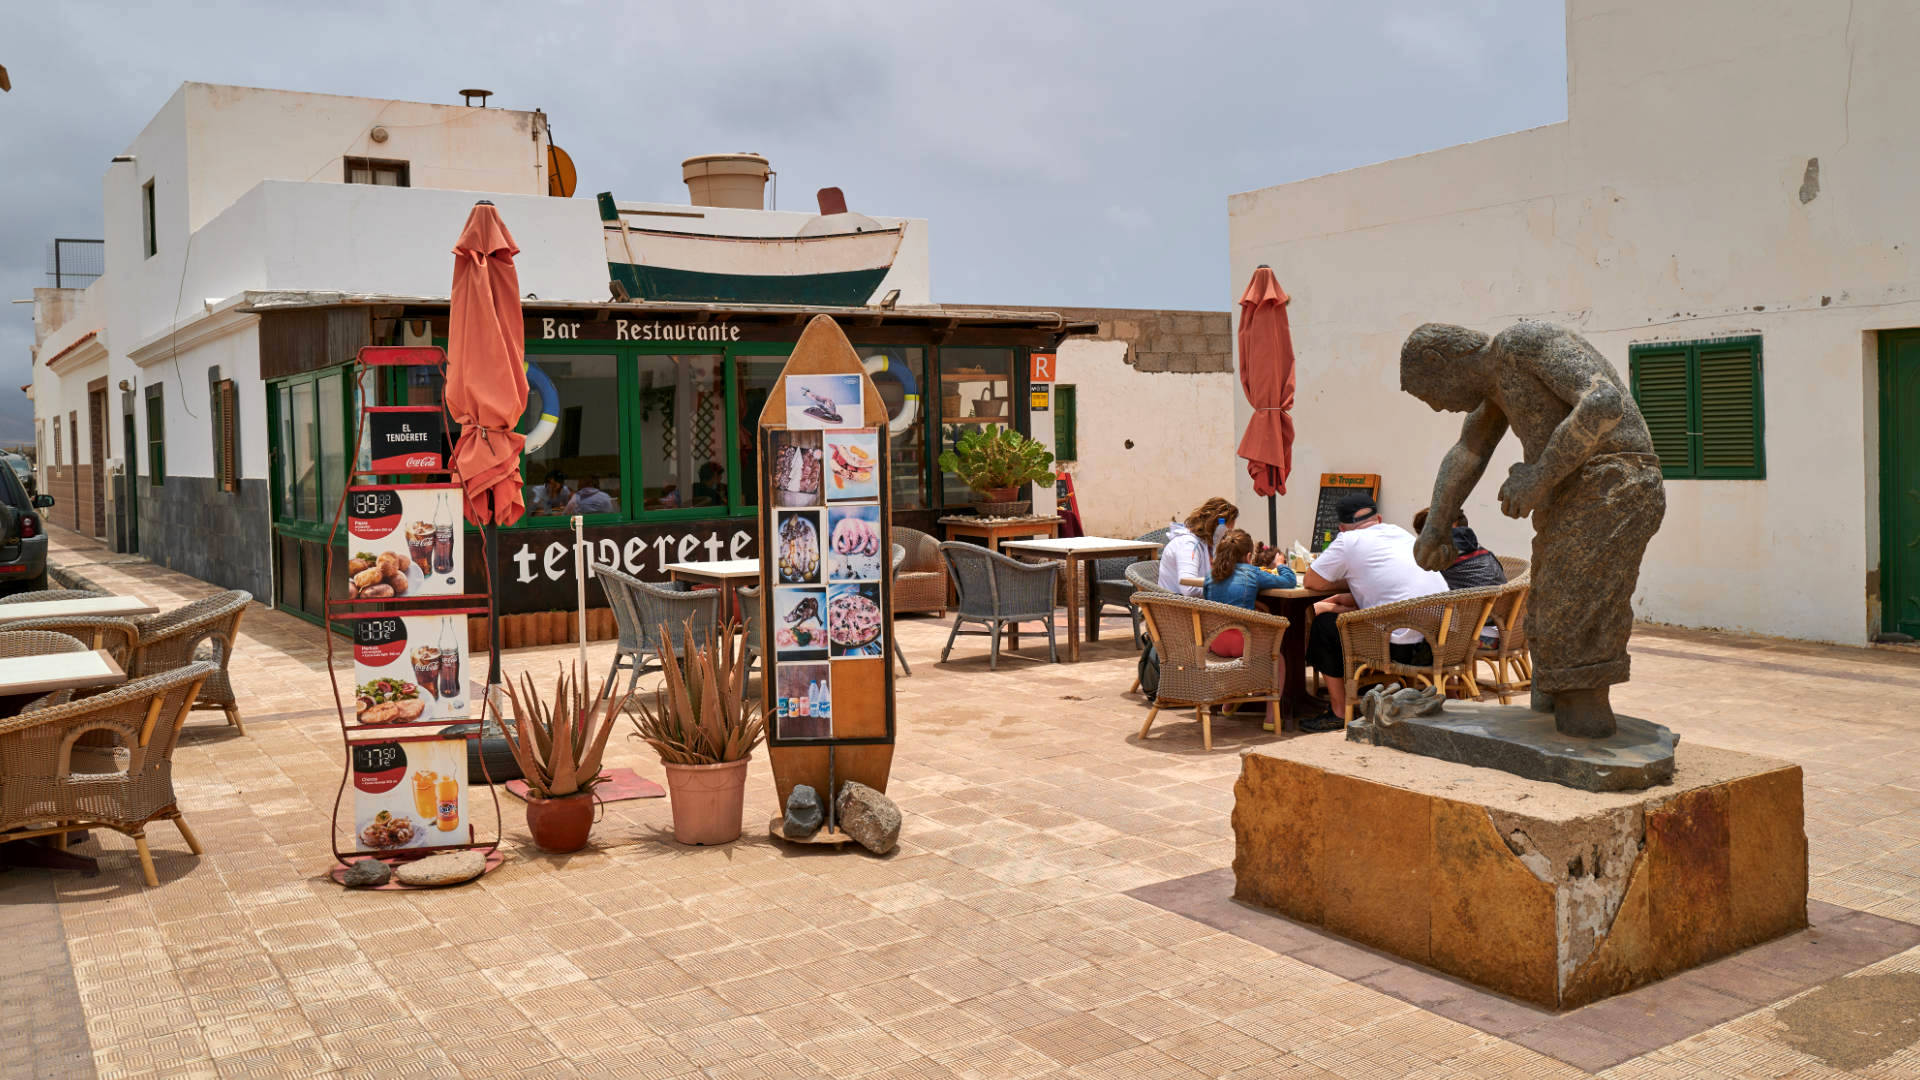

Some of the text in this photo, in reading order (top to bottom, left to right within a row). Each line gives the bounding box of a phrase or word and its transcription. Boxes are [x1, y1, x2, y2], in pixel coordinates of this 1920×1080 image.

[543, 318, 741, 341] Bar Restaurante
[1036, 357, 1049, 378] R
[386, 432, 428, 443] TENDERETE
[402, 424, 411, 432] EL
[513, 530, 753, 584] tenderete
